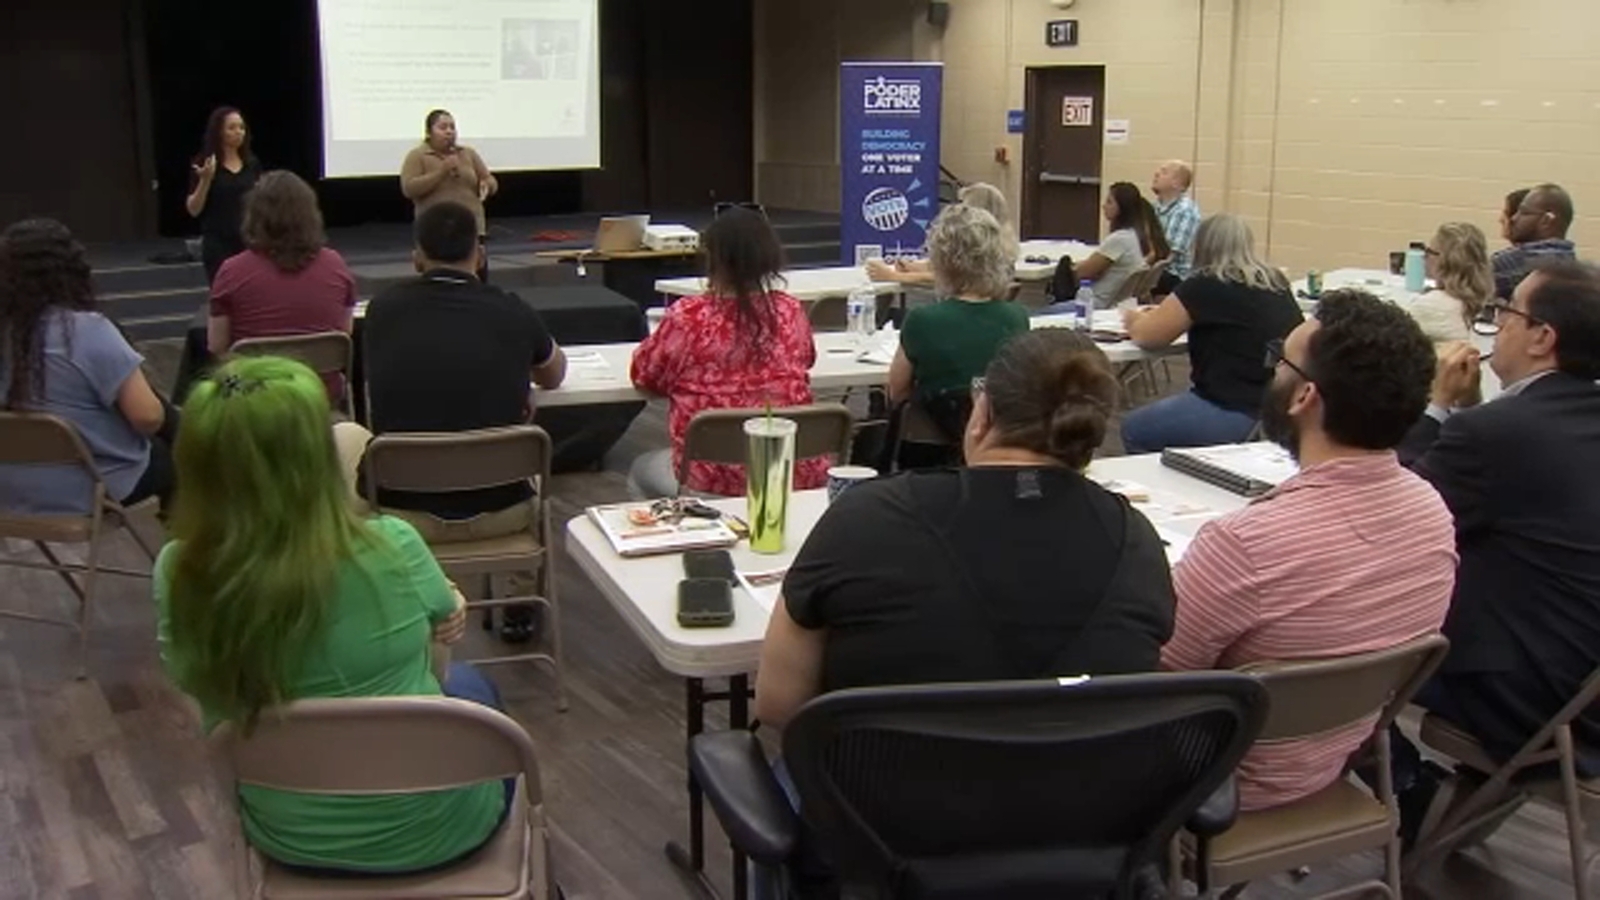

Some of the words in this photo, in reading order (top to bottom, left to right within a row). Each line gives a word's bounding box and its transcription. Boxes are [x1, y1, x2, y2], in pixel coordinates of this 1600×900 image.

[864, 84, 920, 97] PODER
[864, 97, 920, 109] LATINX
[1065, 104, 1091, 123] EXIT
[861, 129, 910, 139] BUILDING
[861, 141, 926, 151] DEMOCRACY
[861, 153, 884, 163] ONE
[886, 153, 921, 163] VOTER
[861, 165, 876, 174] AT
[877, 165, 886, 174] A
[887, 165, 914, 174] TIME
[867, 198, 906, 216] VOTE
